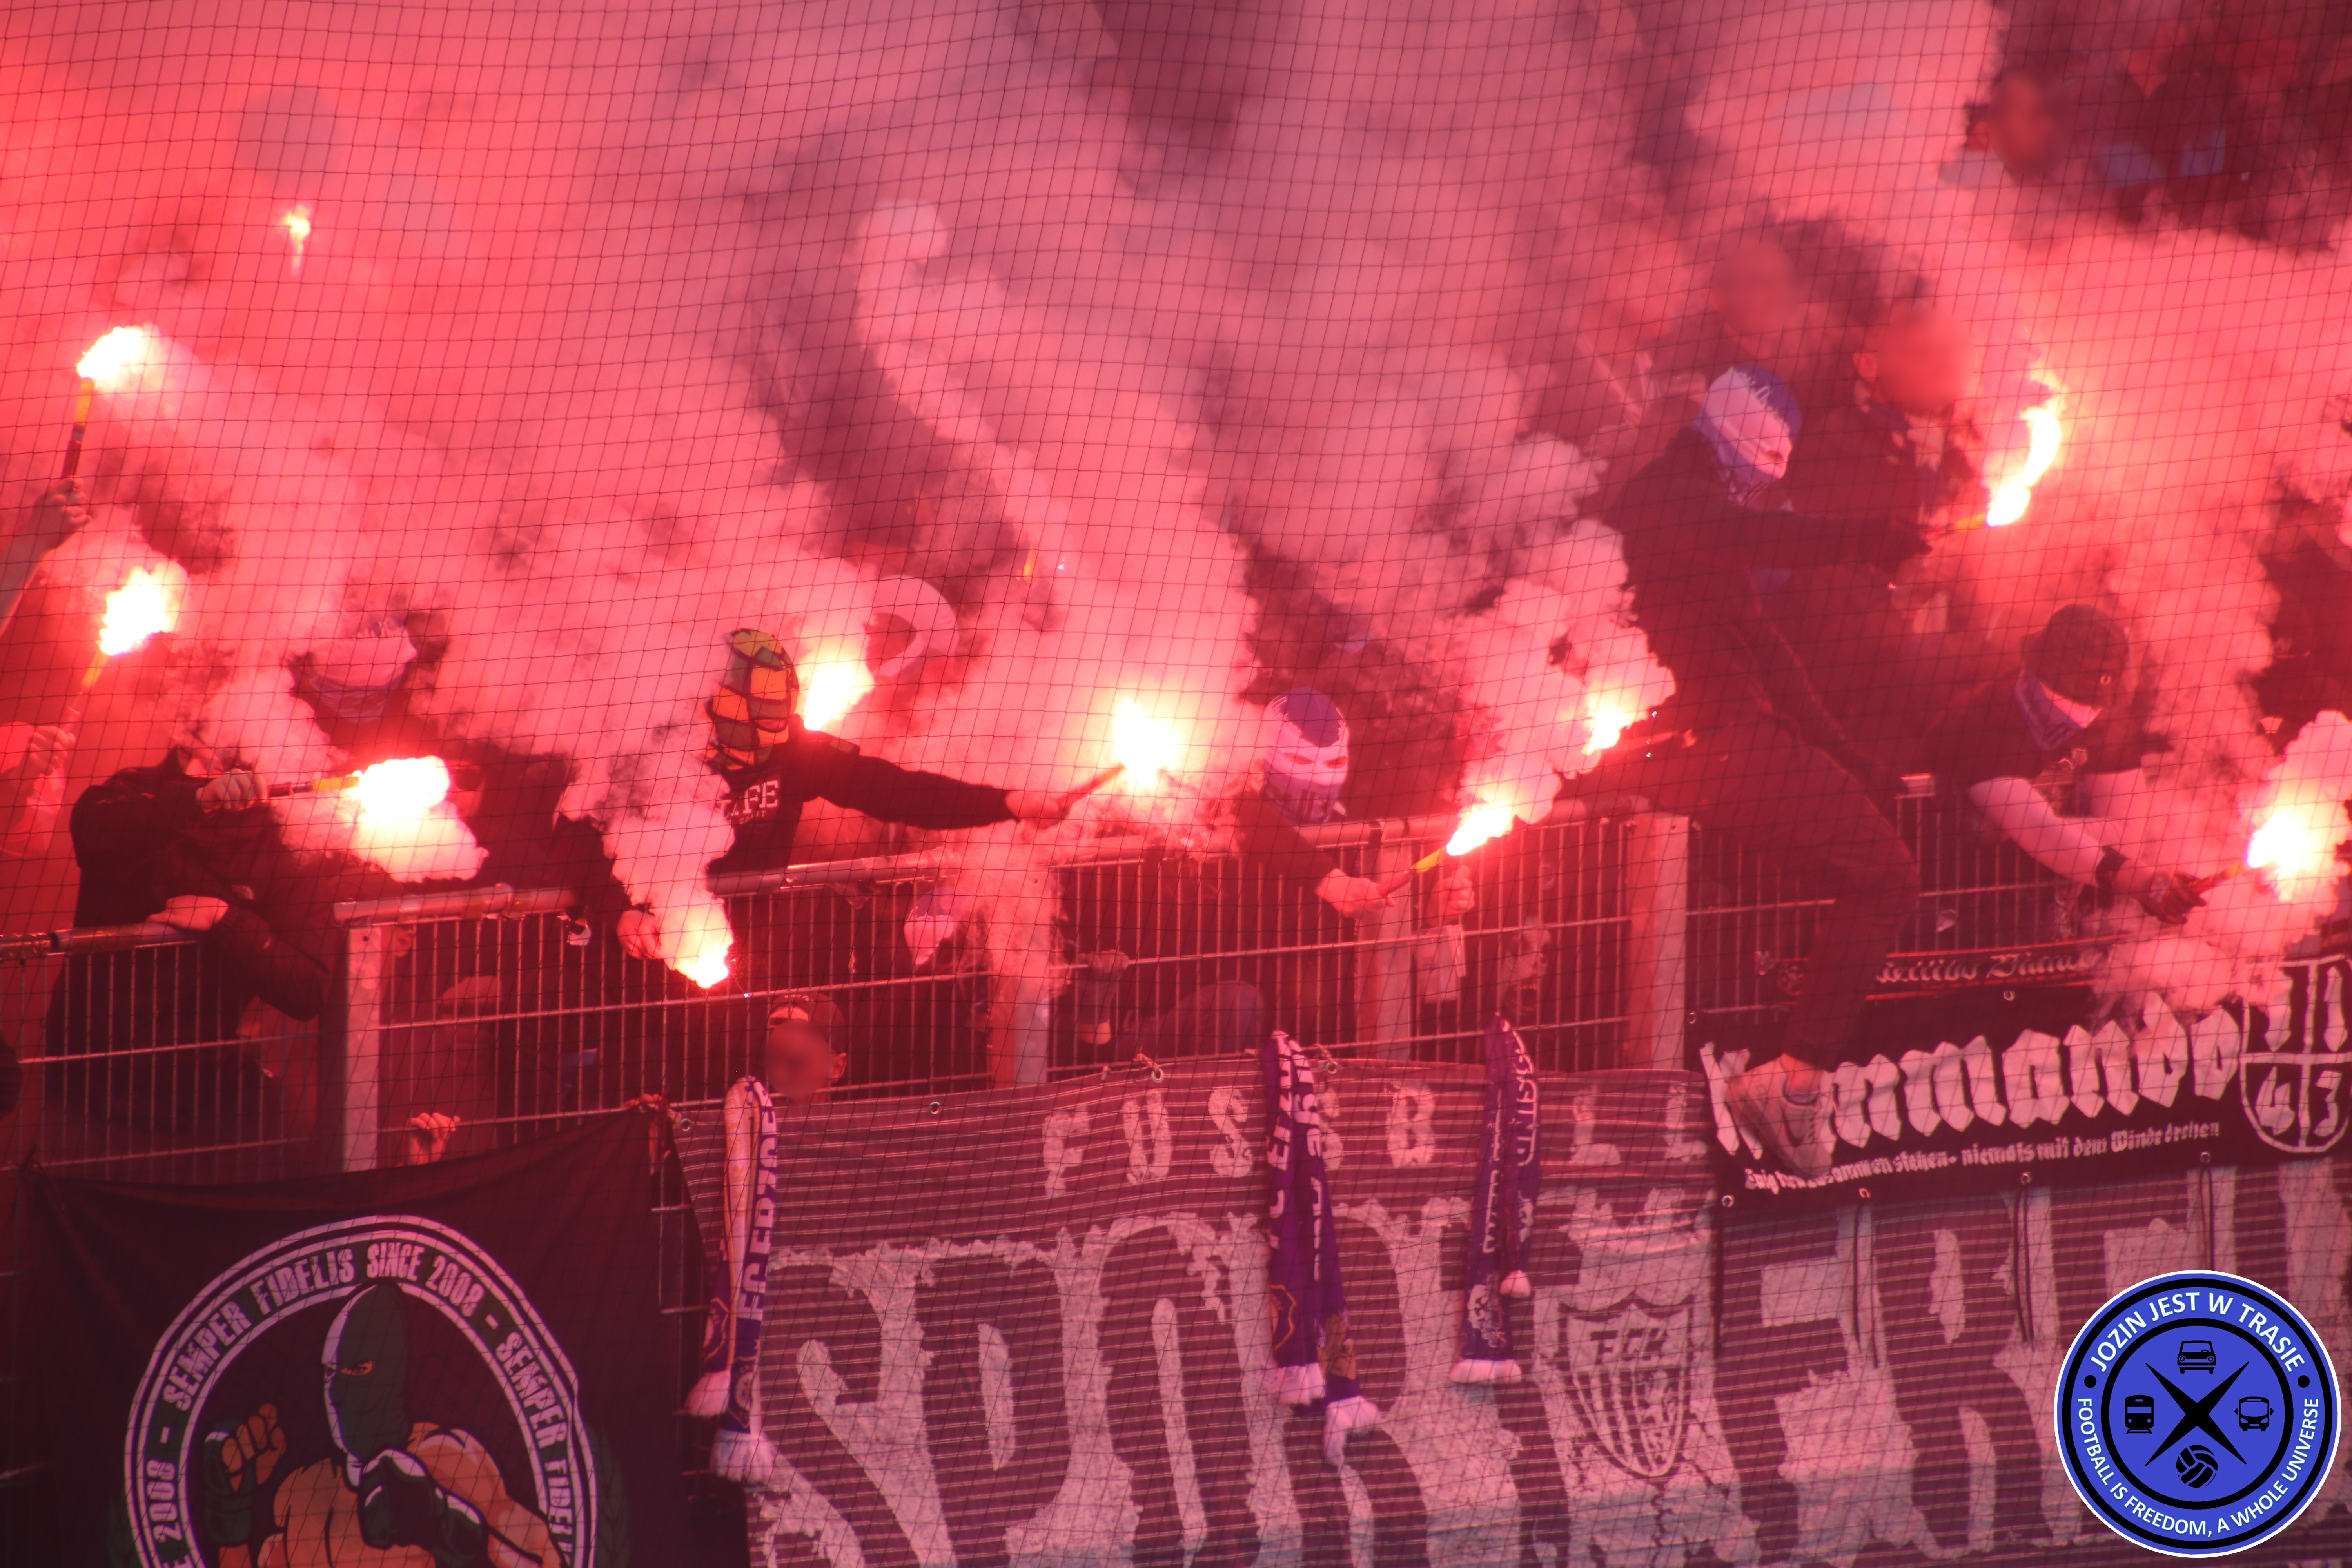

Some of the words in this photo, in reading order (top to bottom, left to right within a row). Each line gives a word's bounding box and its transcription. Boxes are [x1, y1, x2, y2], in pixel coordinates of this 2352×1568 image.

[1700, 992, 2239, 1160] Kmmando
[1960, 1142, 2035, 1166] niemals
[2037, 1136, 2069, 1161] mit
[249, 1248, 355, 1316] FIDELIS
[366, 1242, 425, 1281] SINCE
[425, 1255, 485, 1317] 2008
[162, 1300, 252, 1411] SEMPER
[495, 1332, 568, 1449] SEMPER
[146, 1459, 183, 1543] 2008
[544, 1458, 573, 1565] FIDELI
